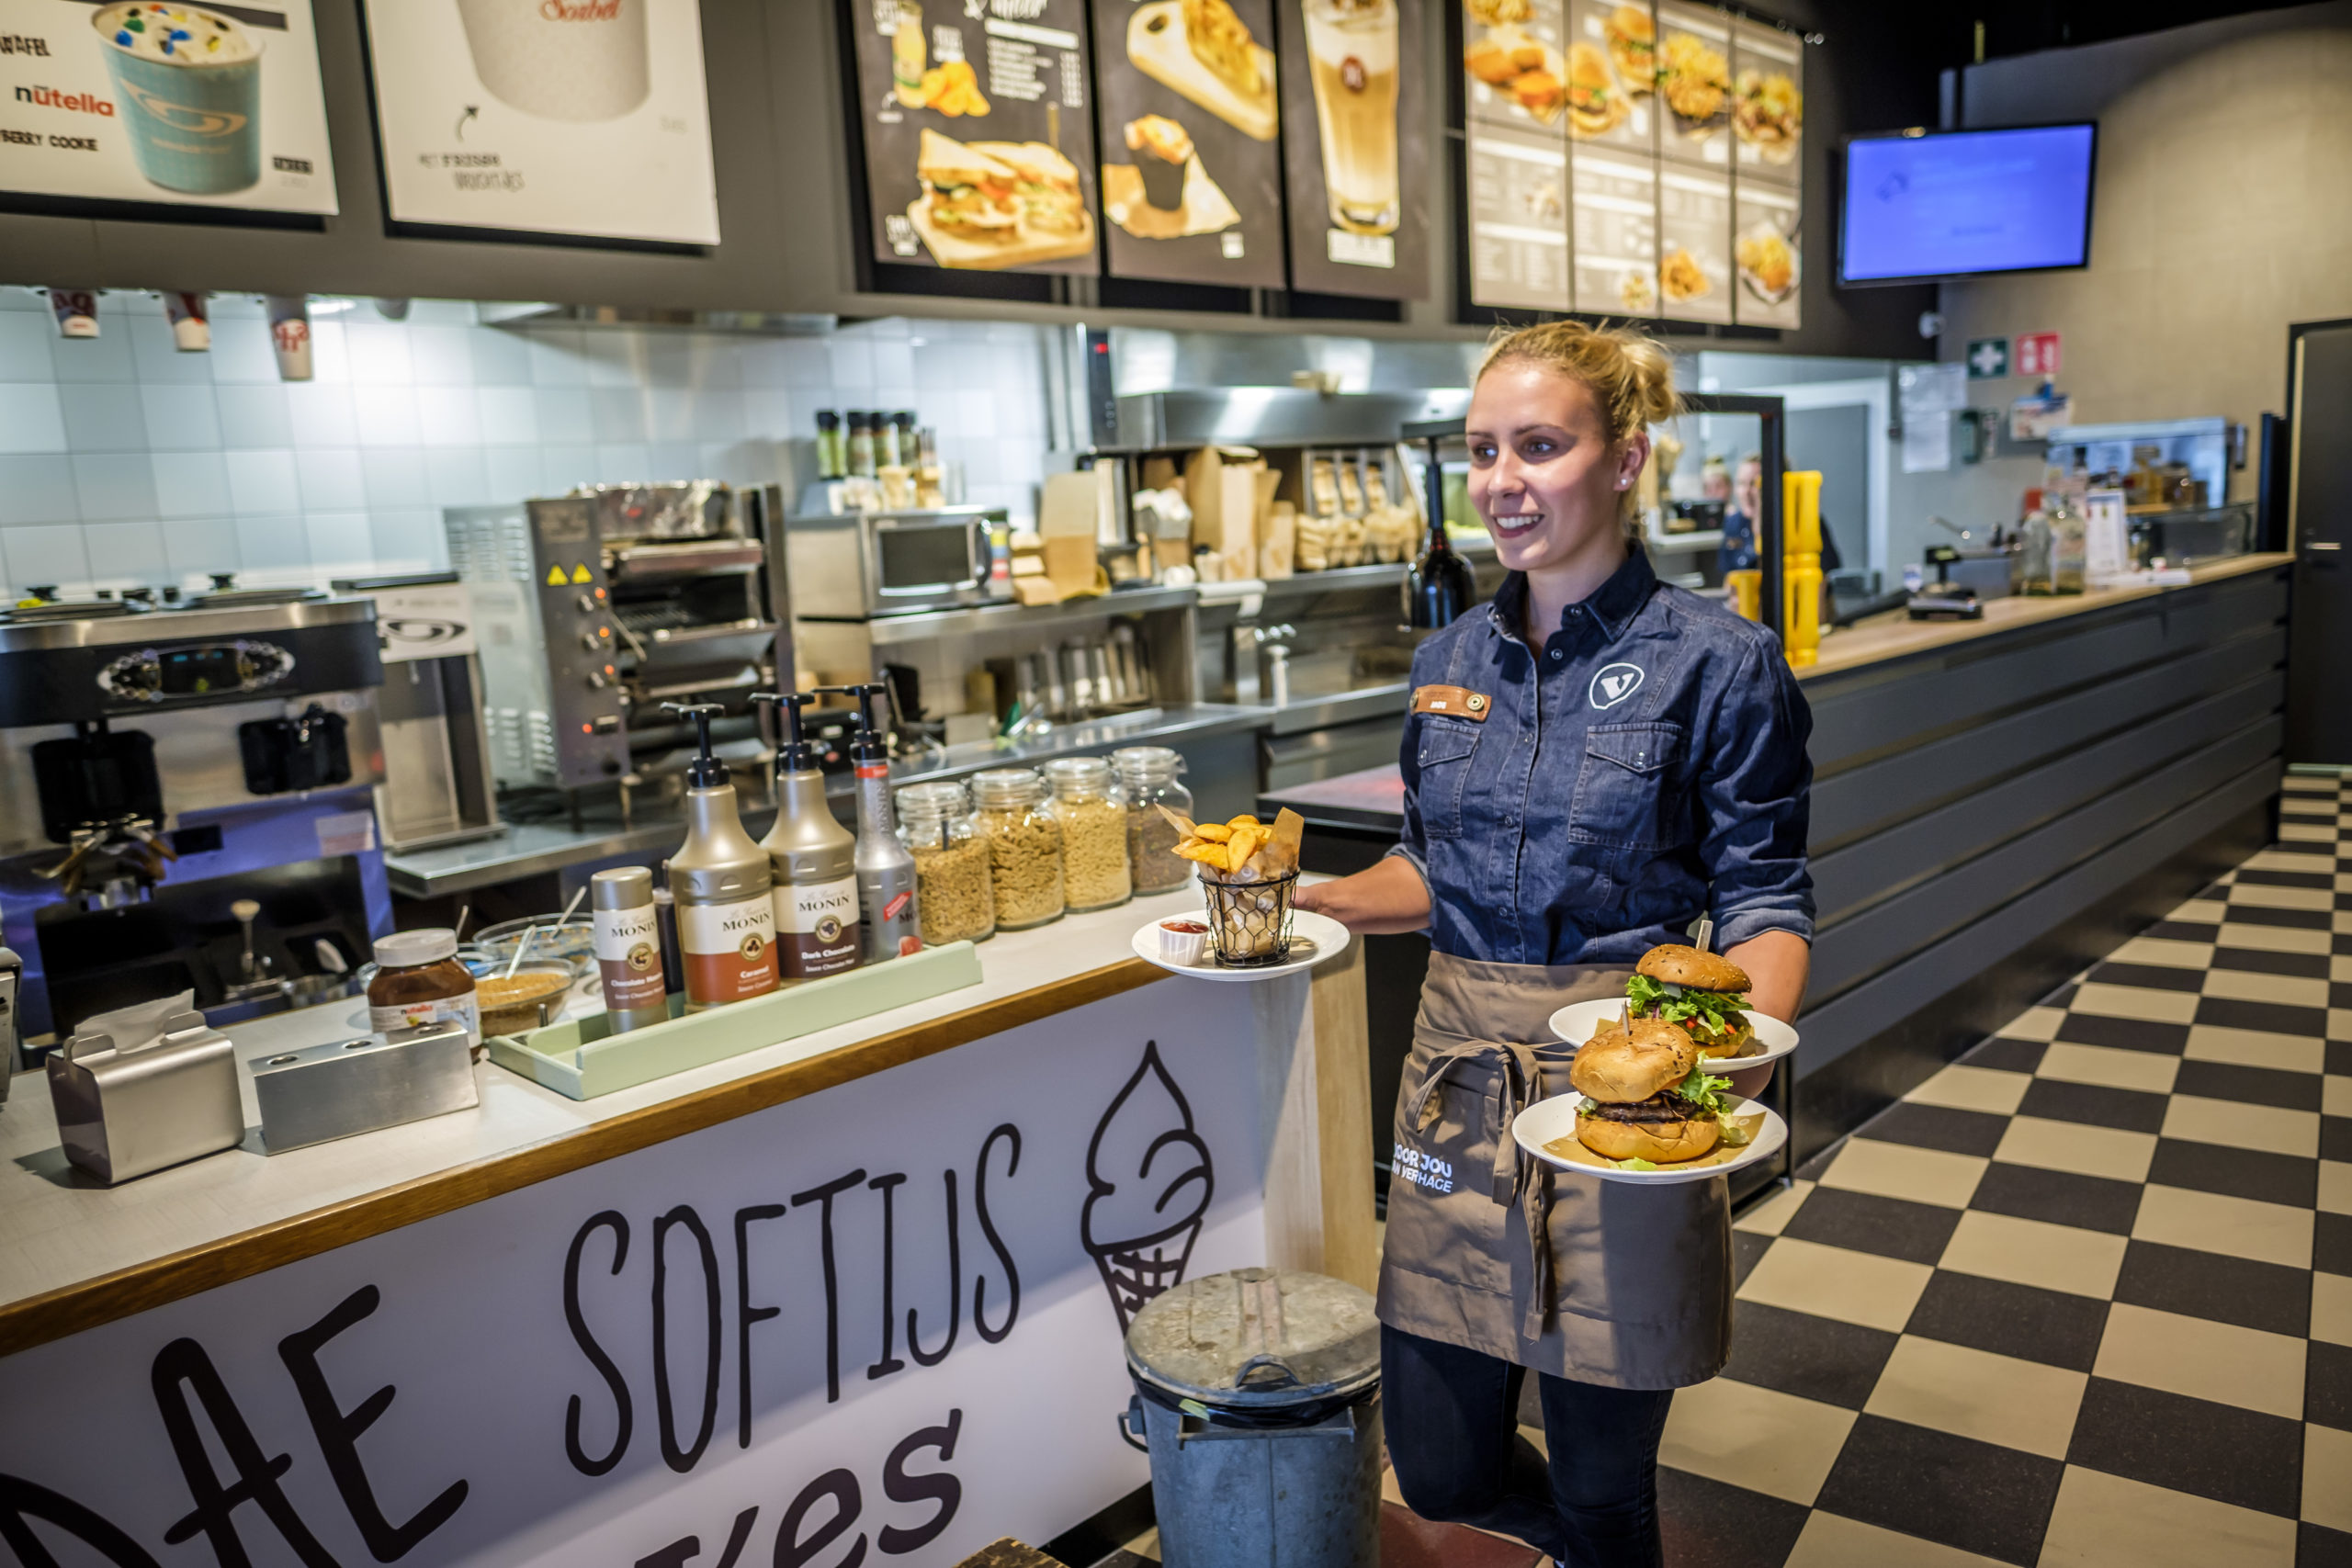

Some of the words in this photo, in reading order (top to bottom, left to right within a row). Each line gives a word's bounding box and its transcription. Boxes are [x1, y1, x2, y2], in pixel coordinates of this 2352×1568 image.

[15, 85, 115, 118] nutella
[798, 896, 851, 912] MONIN
[722, 911, 771, 932] MONIN
[1401, 1165, 1453, 1193] VERHAGE
[1419, 1153, 1453, 1179] JOU
[563, 1122, 1023, 1477] SOFTIJS
